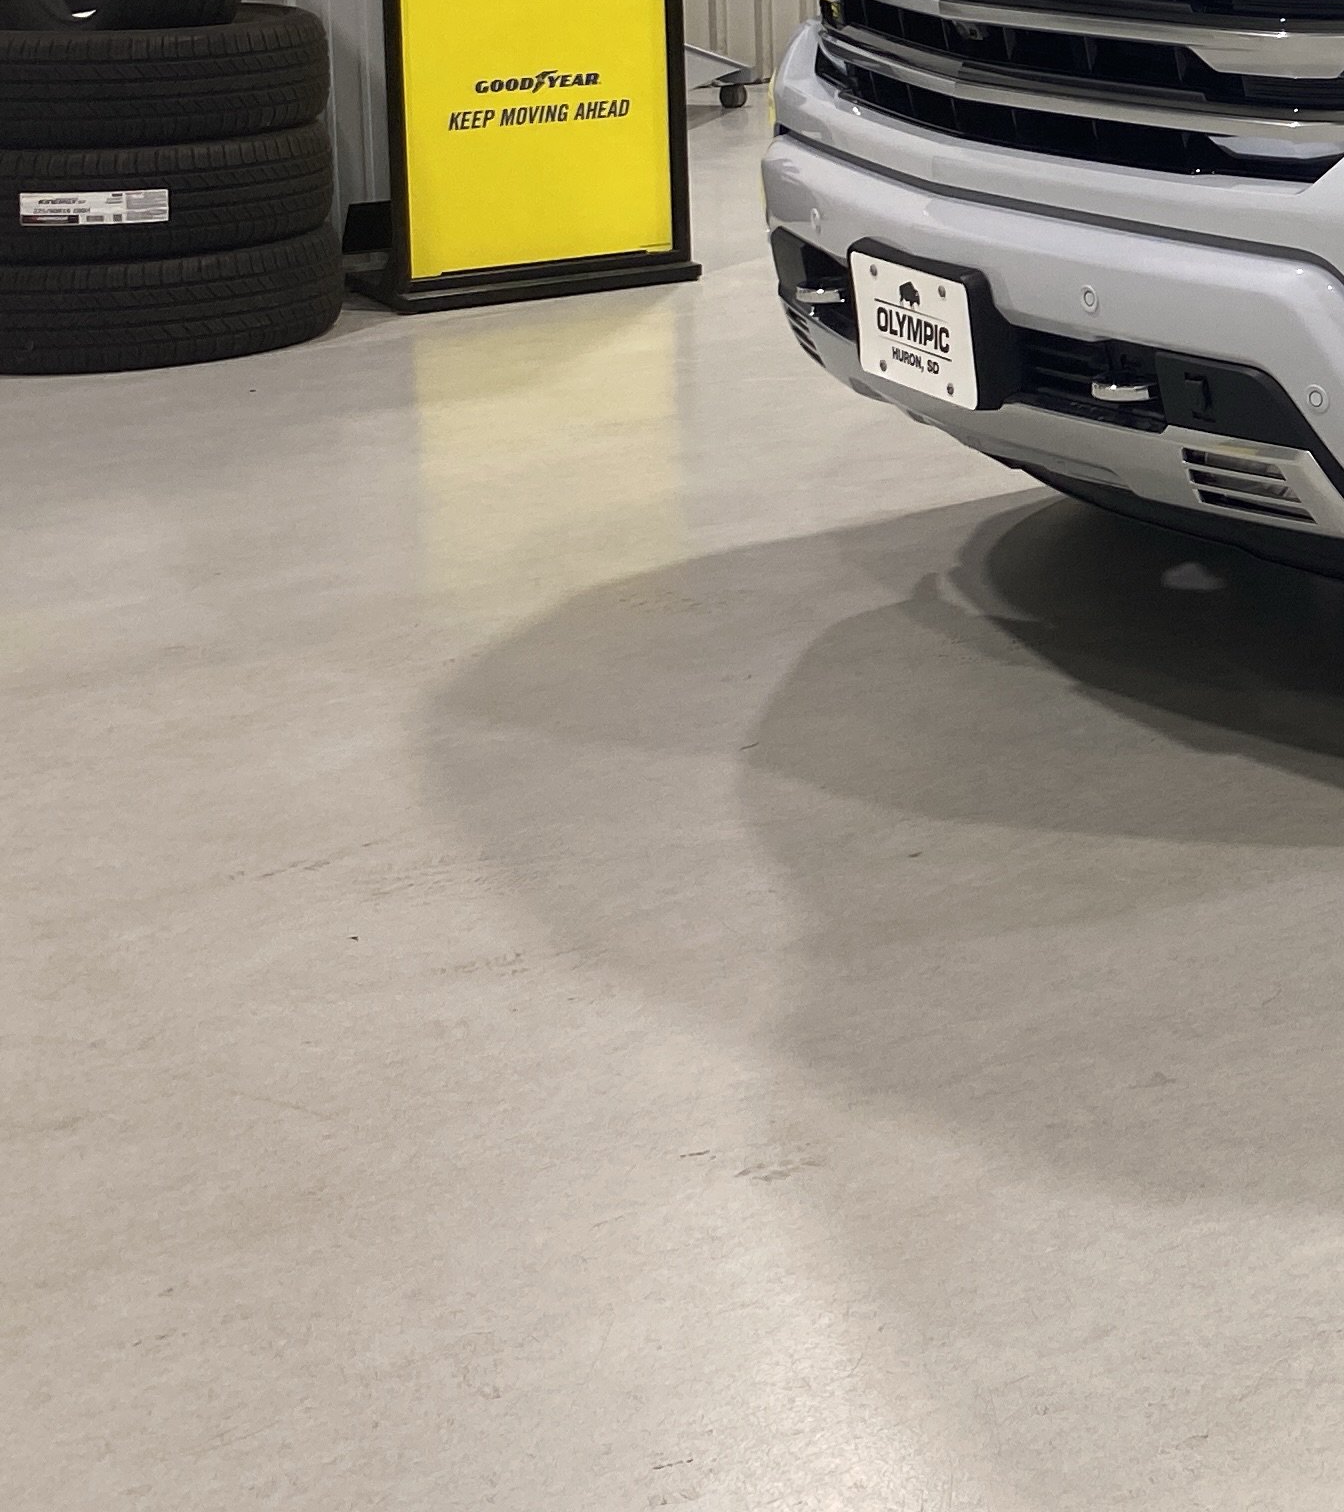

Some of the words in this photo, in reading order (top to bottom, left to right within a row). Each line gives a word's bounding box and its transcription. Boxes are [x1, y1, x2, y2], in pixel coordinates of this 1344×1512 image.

[475, 71, 600, 93] GOODYEAR
[448, 110, 495, 131] KEEP
[500, 103, 569, 127] MOVING
[574, 99, 630, 121] AHEAD
[877, 306, 950, 354] OLYMPIC
[892, 346, 925, 372] HURON,
[927, 359, 940, 374] SD
